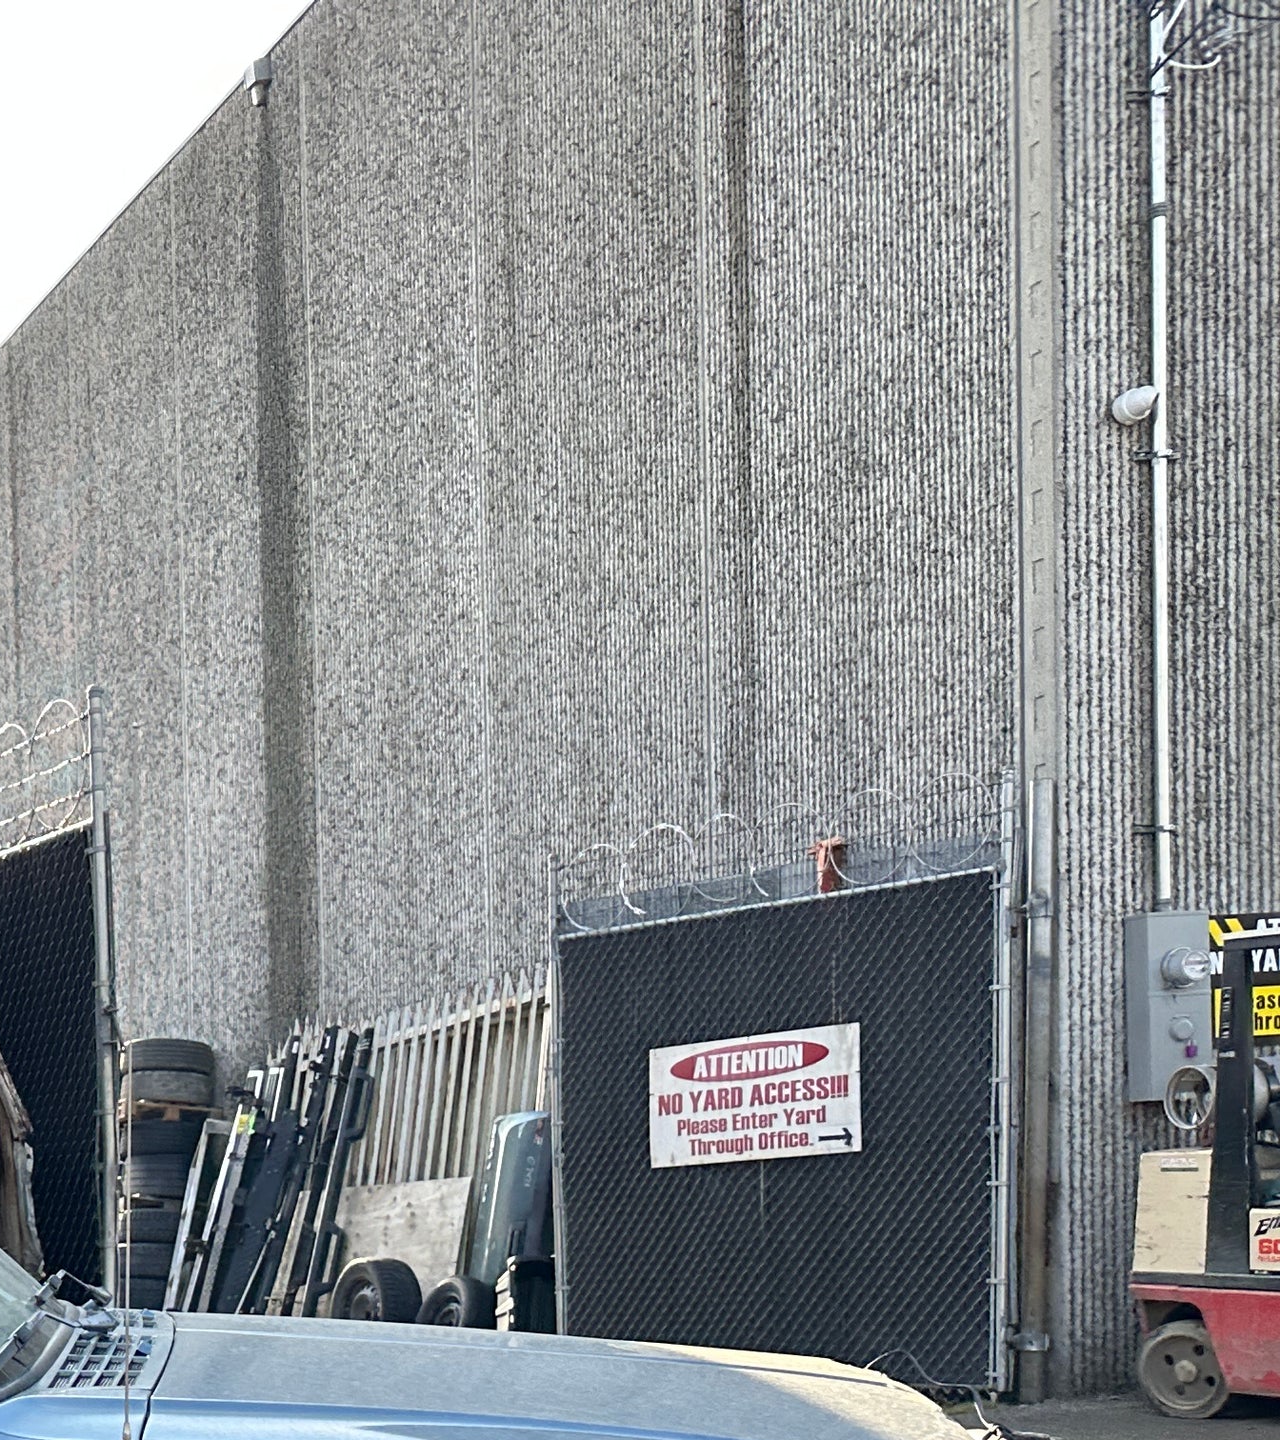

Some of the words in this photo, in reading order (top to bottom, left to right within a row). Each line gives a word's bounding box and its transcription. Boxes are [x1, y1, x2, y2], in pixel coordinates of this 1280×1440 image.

[692, 1043, 804, 1080] ATTENTION
[658, 1093, 683, 1117] NO
[689, 1086, 742, 1114] YARD
[750, 1074, 850, 1107] ACCESS!!!
[677, 1118, 728, 1137] Please
[732, 1111, 778, 1131] Enter
[783, 1104, 827, 1127] Yard
[689, 1134, 754, 1156] Through
[758, 1131, 815, 1151] Office.
